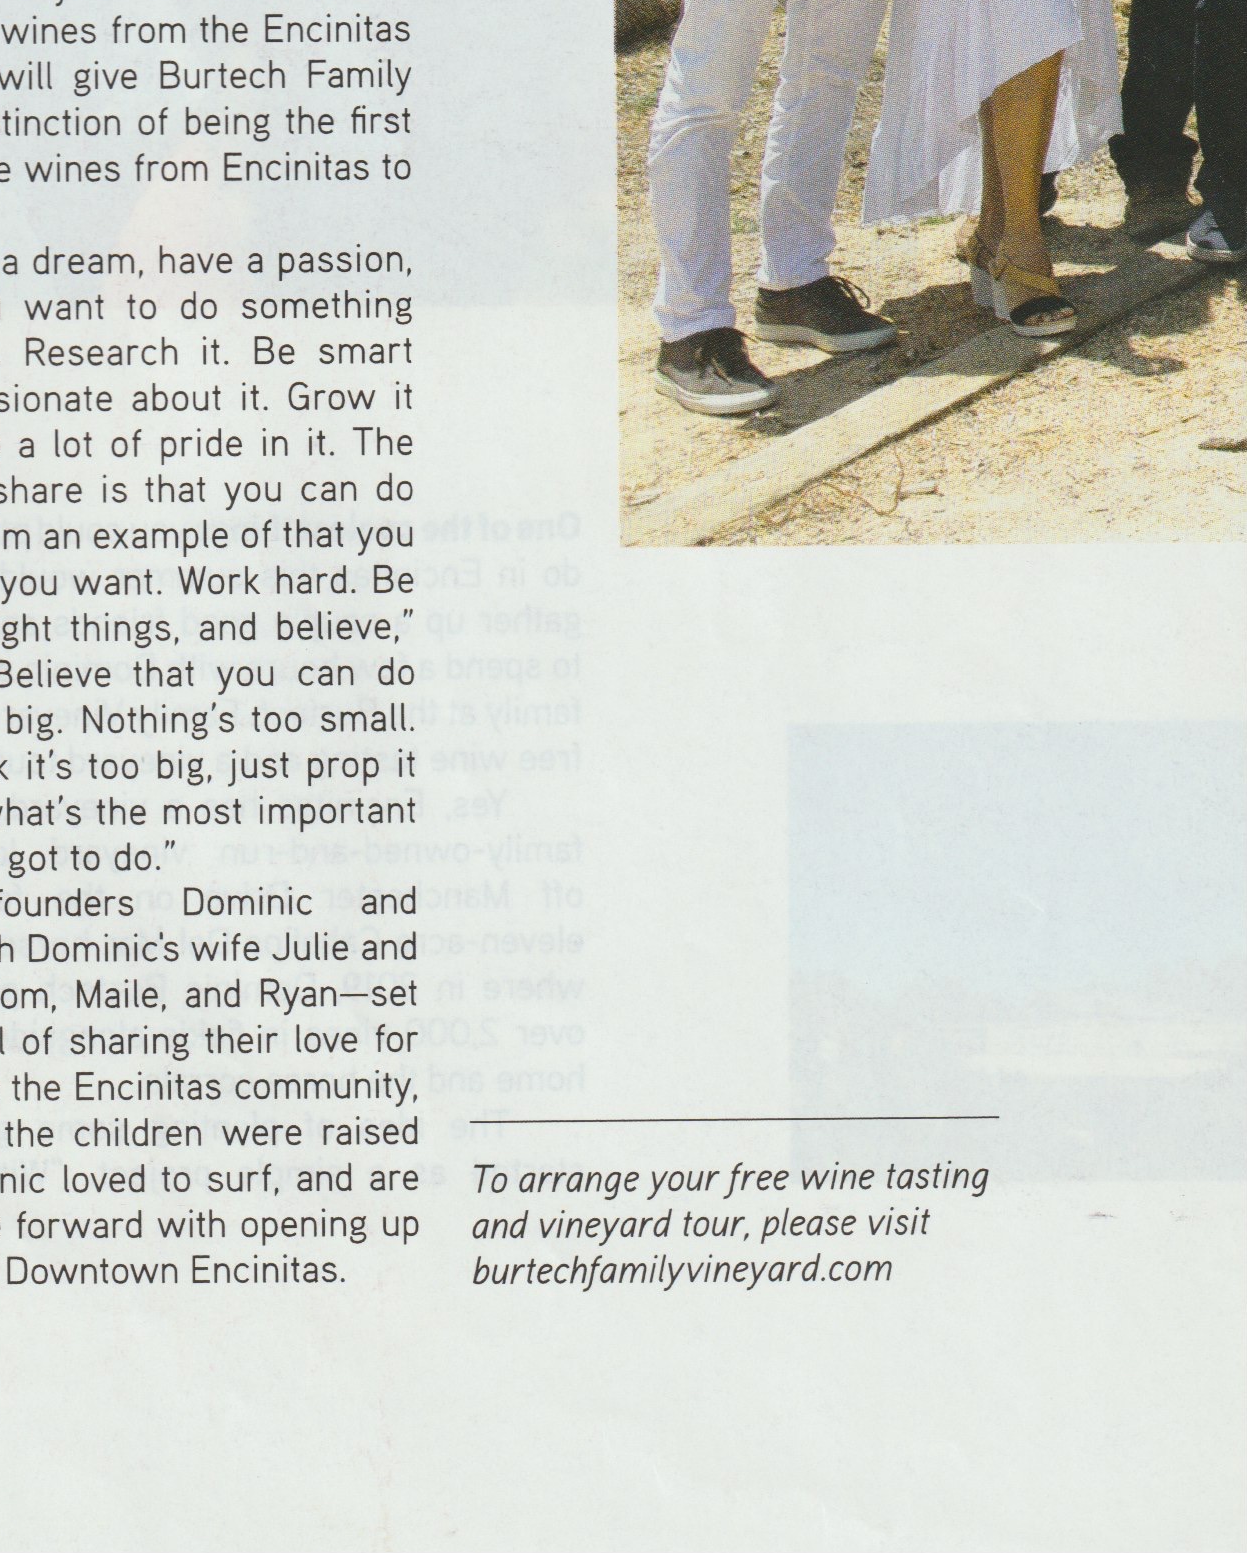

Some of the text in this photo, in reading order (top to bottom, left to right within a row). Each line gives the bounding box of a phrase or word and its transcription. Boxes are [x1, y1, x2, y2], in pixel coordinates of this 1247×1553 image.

[0, 15, 97, 45] wines
[112, 14, 186, 44] from
[199, 14, 249, 44] the
[264, 13, 411, 43] Encinitas
[138, 106, 169, 136] of
[185, 105, 270, 142] being
[285, 105, 335, 135] the
[350, 104, 411, 134] first
[24, 294, 104, 321] want
[126, 294, 157, 320] to
[180, 290, 218, 320] do
[241, 289, 413, 326] something
[183, 886, 313, 916] Dominic
[361, 885, 416, 915] and
[22, 1025, 53, 1056] of
[70, 1025, 190, 1062] sharing
[204, 1024, 279, 1054] their
[296, 1024, 358, 1054] love
[375, 1023, 419, 1053] for
[4, 1118, 54, 1148] the
[74, 1117, 202, 1147] children
[221, 1124, 302, 1146] were
[323, 1115, 418, 1146] raised
[473, 1160, 989, 1201] To arrange your free wine tasting
[472, 1206, 931, 1247] and vineyard tour, please visit
[6, 1256, 178, 1285] Downtown
[192, 1254, 346, 1284] Encinitas.
[472, 1252, 893, 1293] burtechfamilyvineyard.com
